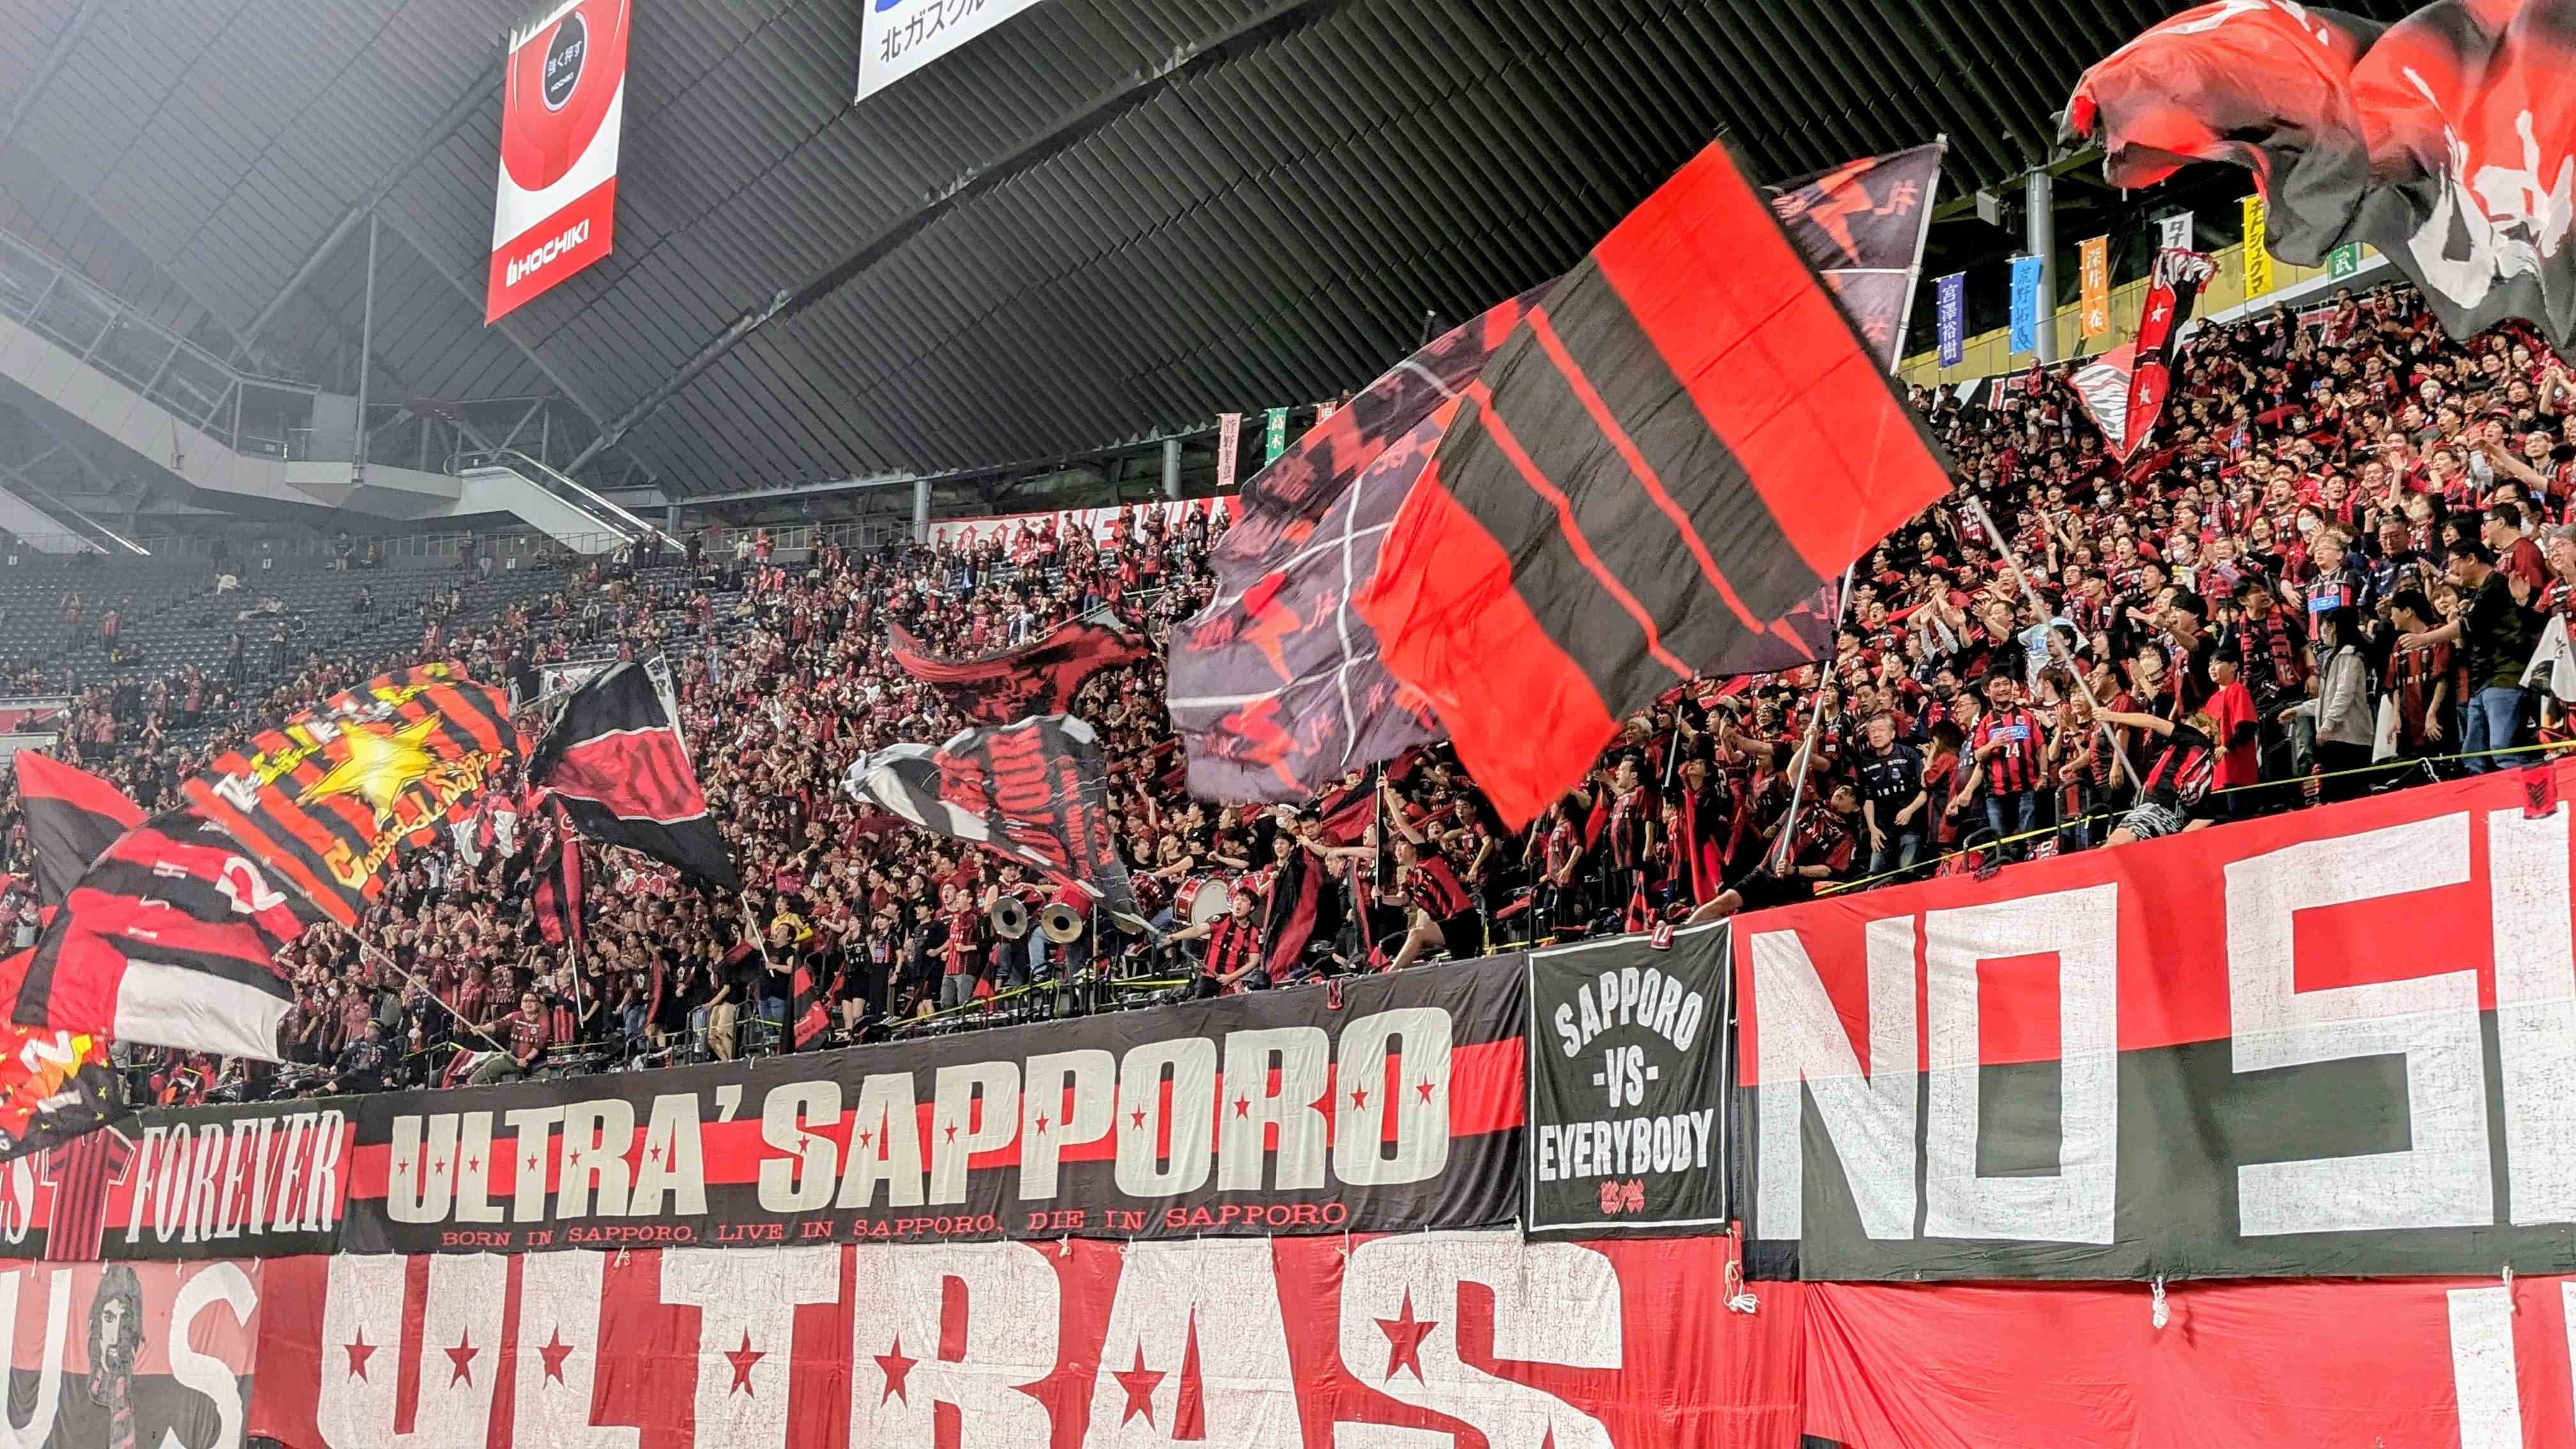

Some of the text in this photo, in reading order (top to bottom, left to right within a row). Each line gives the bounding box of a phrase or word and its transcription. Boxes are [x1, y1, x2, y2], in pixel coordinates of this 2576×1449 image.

[518, 218, 590, 281] HOCHIKI
[2015, 264, 2032, 350] 荒野拓馬
[1271, 414, 1284, 464] 高木
[1555, 967, 1703, 1058] SAPPORO
[1751, 882, 2117, 1244] NO
[125, 1109, 344, 1245] FOREVER
[1539, 1108, 1714, 1181] EVERYBODY
[441, 1202, 1348, 1248] BORN IN SAPPORO, LIVE IN SAPPORO, DIE IN SAPPORO
[318, 1229, 1623, 1449] ULTRAS
